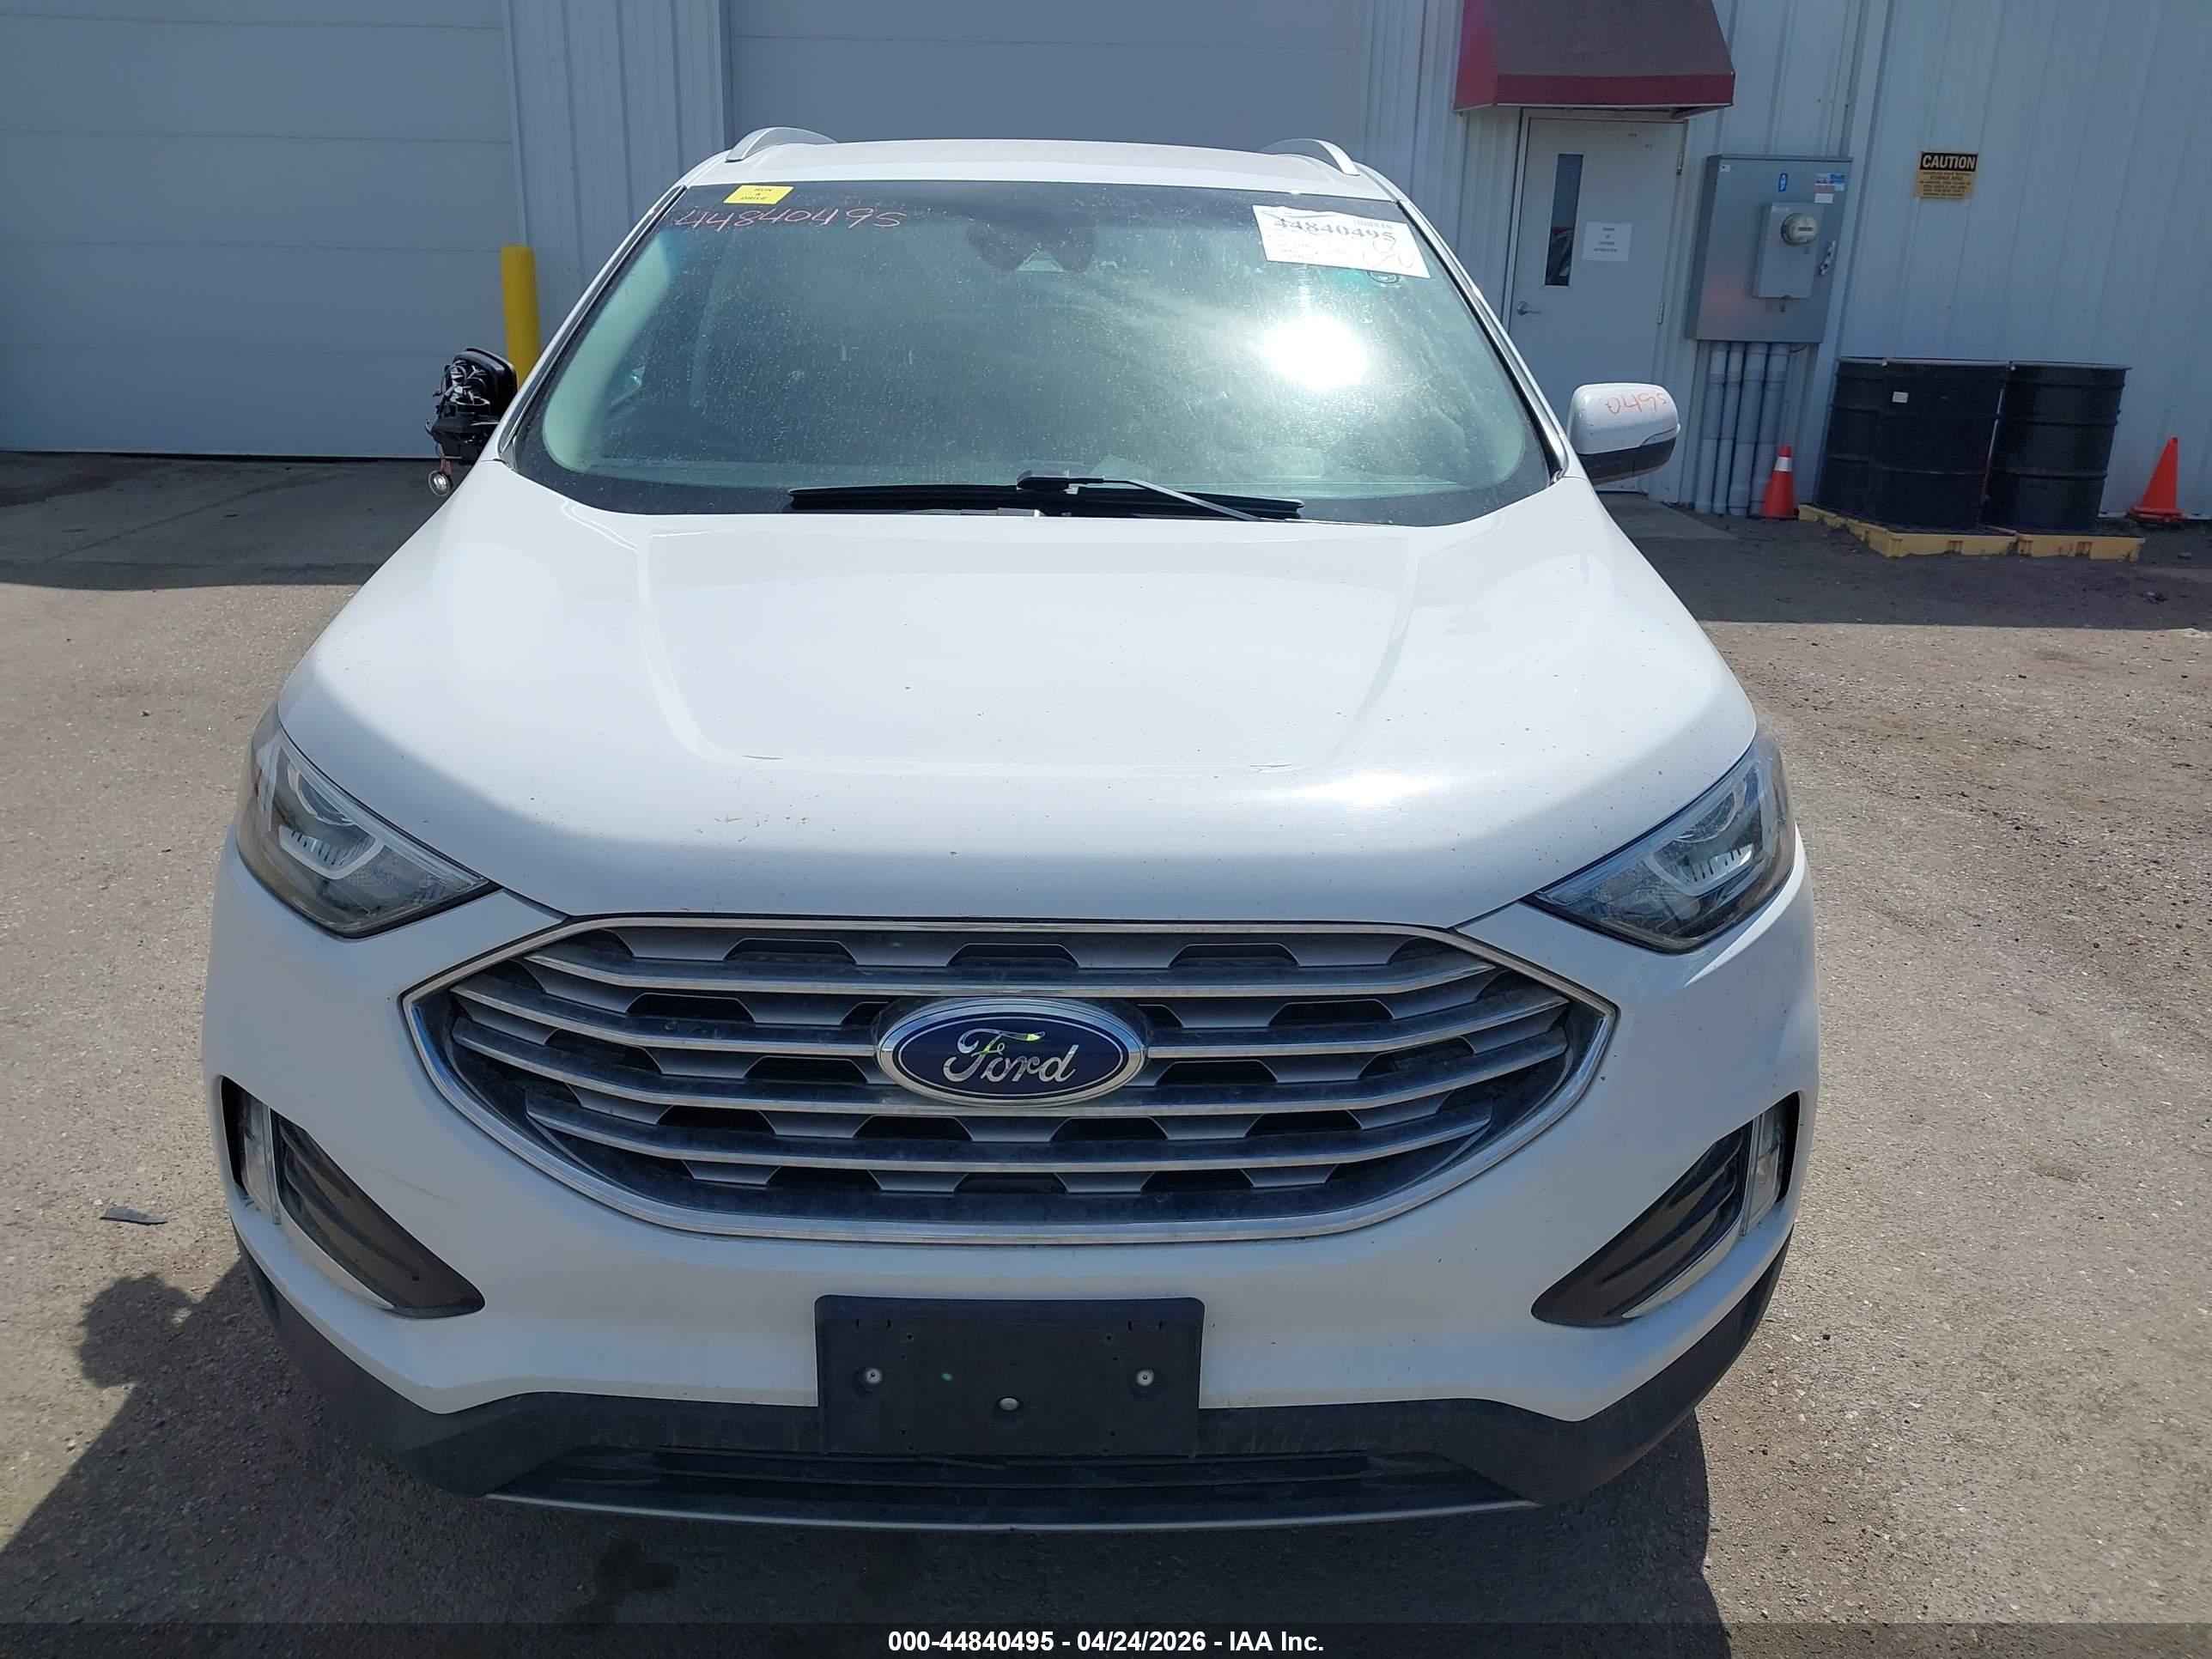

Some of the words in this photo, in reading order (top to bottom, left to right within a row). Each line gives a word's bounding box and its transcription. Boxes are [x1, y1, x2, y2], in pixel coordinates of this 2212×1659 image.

[1923, 155, 1976, 169] CAUTION
[1605, 392, 1668, 414] 0495
[943, 1028, 1079, 1083] Ford
